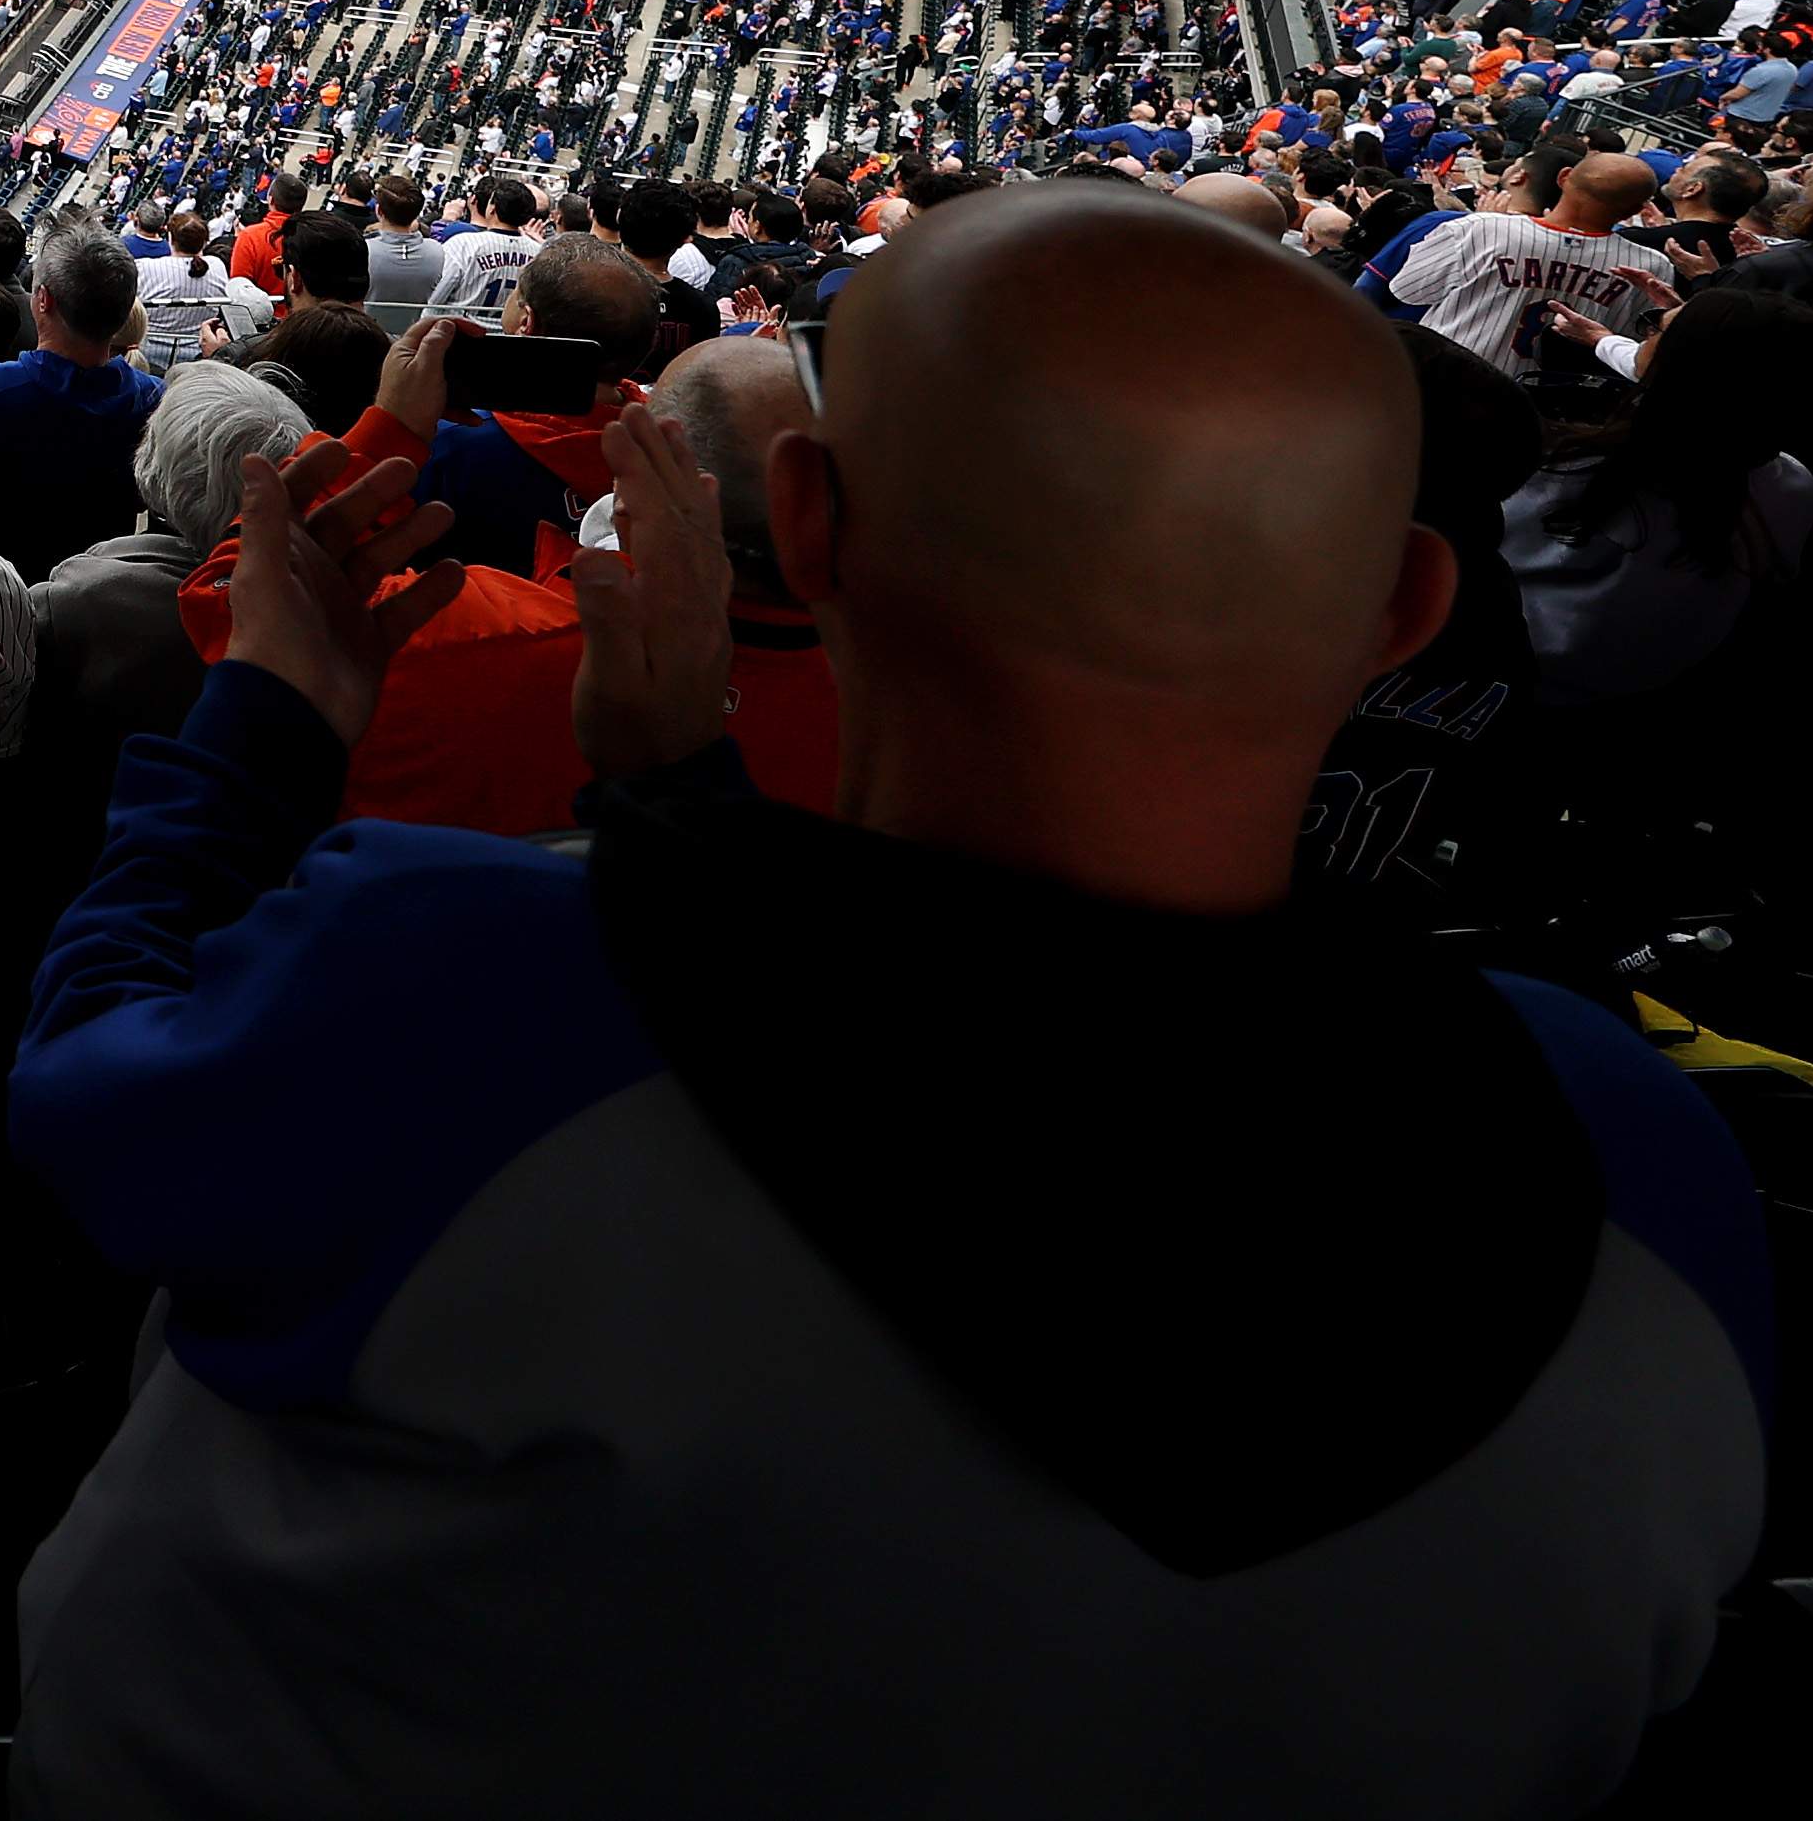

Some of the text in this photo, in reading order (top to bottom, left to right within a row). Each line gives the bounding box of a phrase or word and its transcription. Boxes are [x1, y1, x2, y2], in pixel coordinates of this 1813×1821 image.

[137, 3, 177, 37] YORK
[115, 27, 157, 59] NEW
[95, 54, 139, 81] THE
[1497, 256, 1630, 307] CARTER
